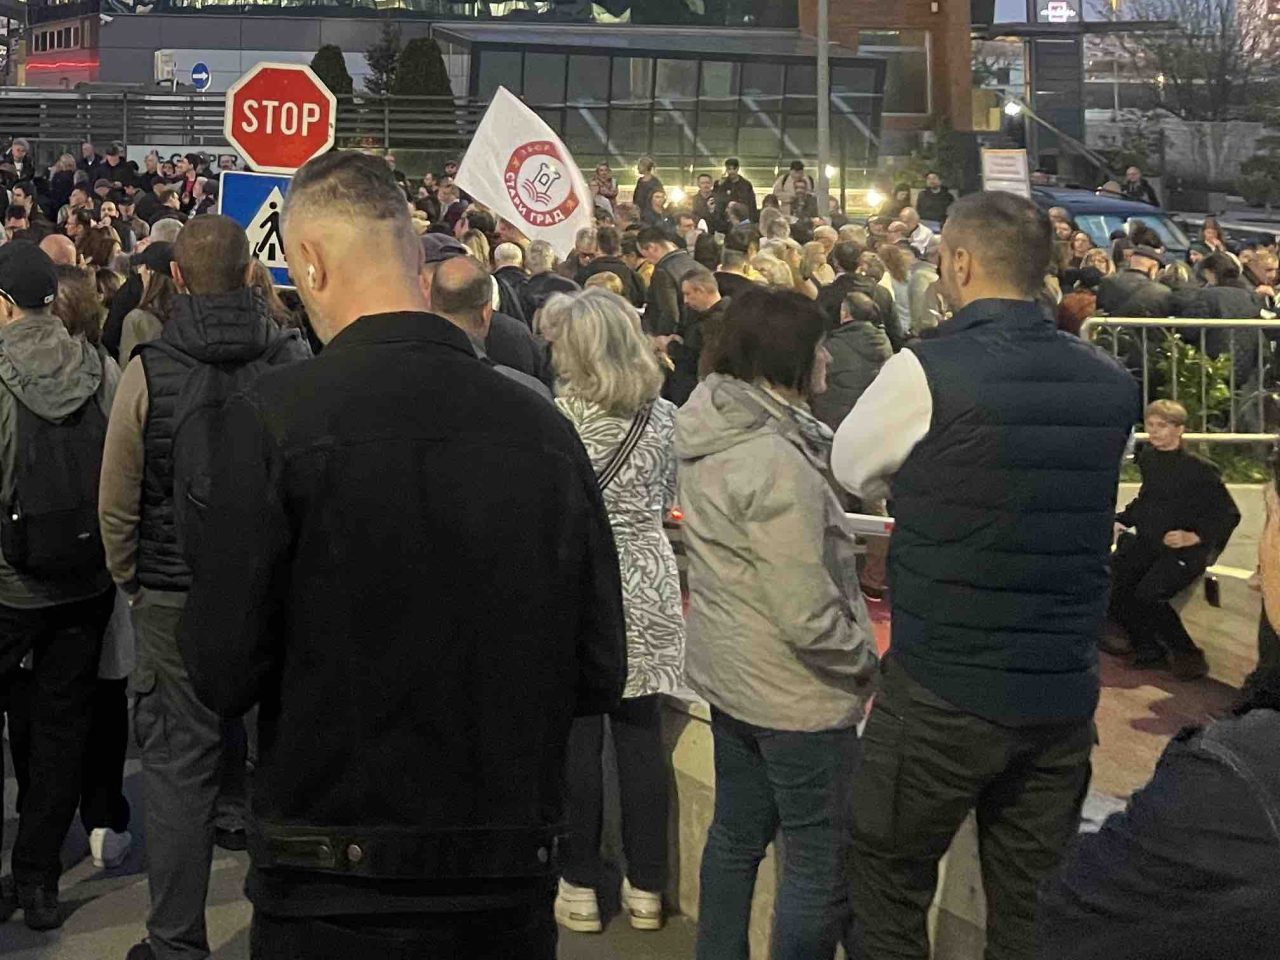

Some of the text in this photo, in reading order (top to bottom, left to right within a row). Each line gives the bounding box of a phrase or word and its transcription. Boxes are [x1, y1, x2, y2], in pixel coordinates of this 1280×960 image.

[241, 99, 321, 137] STOP
[505, 171, 566, 225] СТАРИ ГРАД
